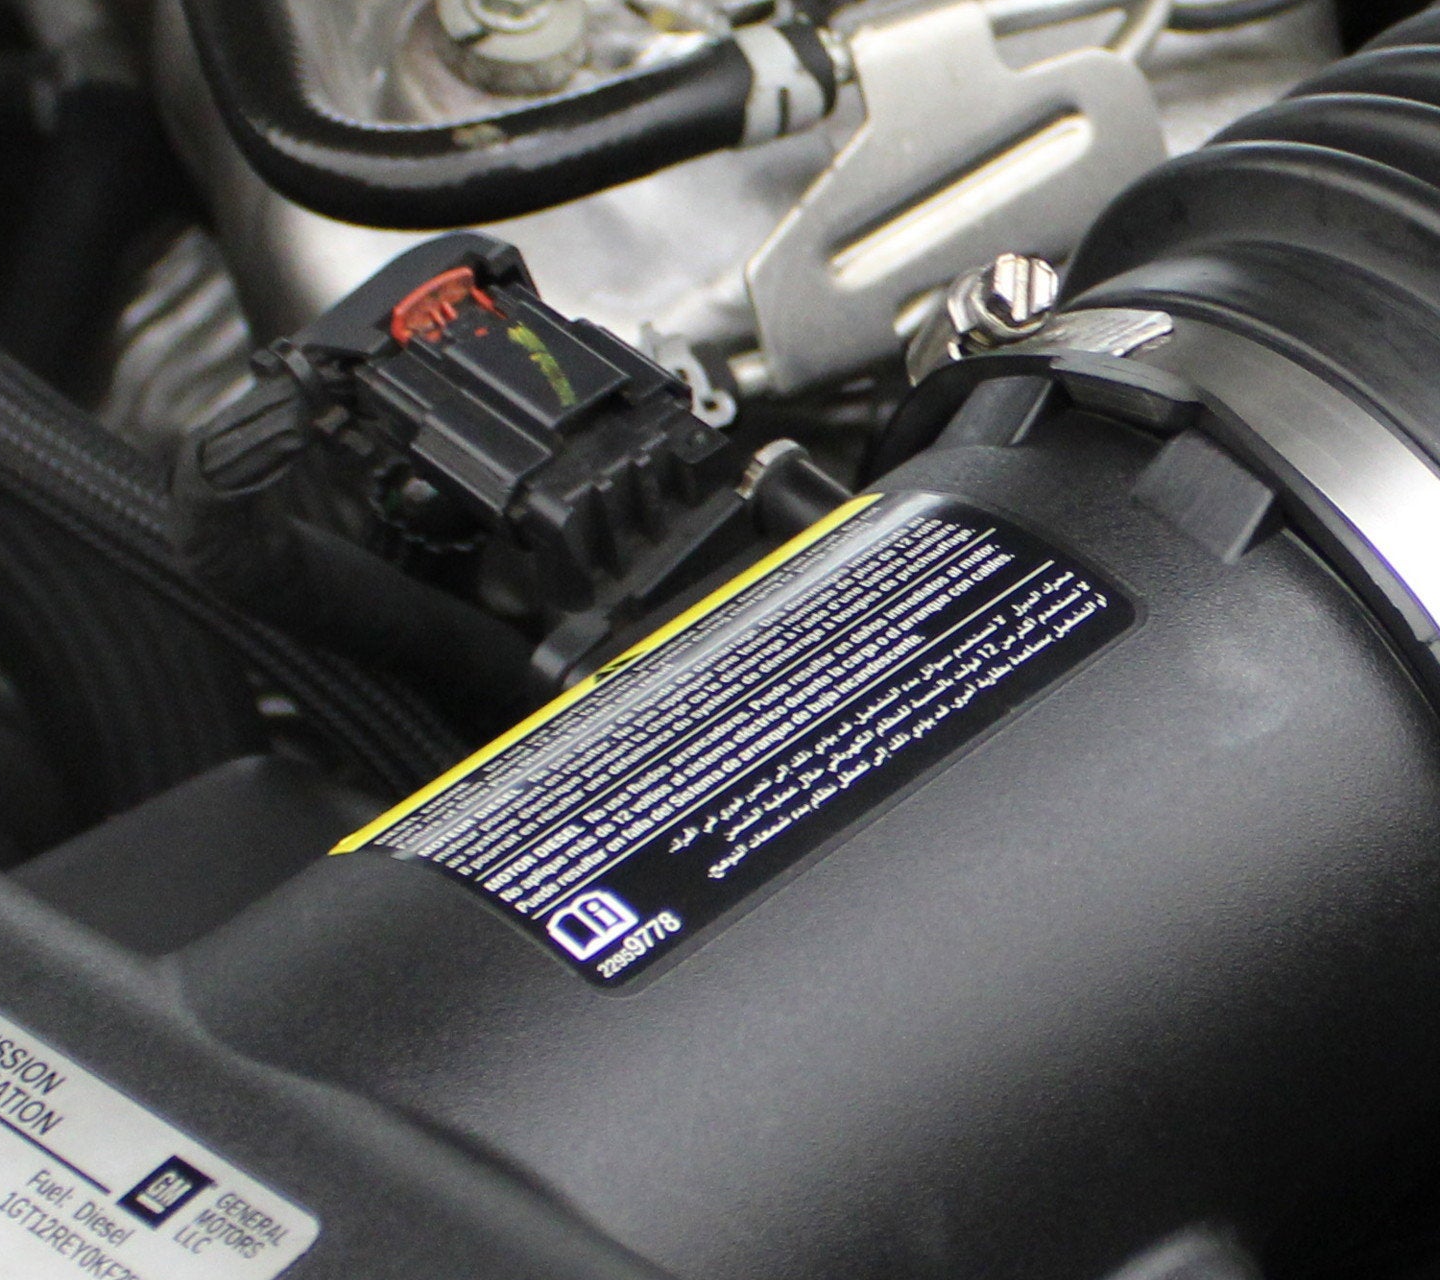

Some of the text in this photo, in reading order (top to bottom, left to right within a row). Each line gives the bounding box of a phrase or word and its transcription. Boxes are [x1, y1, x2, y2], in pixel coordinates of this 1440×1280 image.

[482, 542, 1000, 891] MOTOR DIESEL No use fluidos arrancadores. Puede resultar en daños inmediatos al motor.
[498, 885, 525, 902] No
[517, 854, 571, 890] aplique
[563, 835, 599, 858] más
[592, 822, 617, 838] de
[610, 809, 635, 824] 12
[627, 783, 674, 813] voltios
[668, 772, 689, 786] al
[681, 740, 738, 777] sistema
[730, 704, 789, 743] eléctrico
[782, 674, 834, 708] durante
[825, 665, 847, 677] la
[839, 642, 882, 669] carga
[883, 626, 903, 639] el
[895, 593, 954, 631] arranque
[945, 578, 975, 596] con
[968, 552, 1015, 581] cables.
[513, 633, 926, 913] Puede resultar en falla del Sistema de arranque de bujía incandescente.
[590, 911, 684, 978] 22959778
[25, 1168, 135, 1246] Fuel: Diesel
[142, 1169, 193, 1209] GM
[215, 1191, 289, 1246] GENERAL
[172, 1224, 213, 1255] LLC
[193, 1208, 265, 1259] MOTORS
